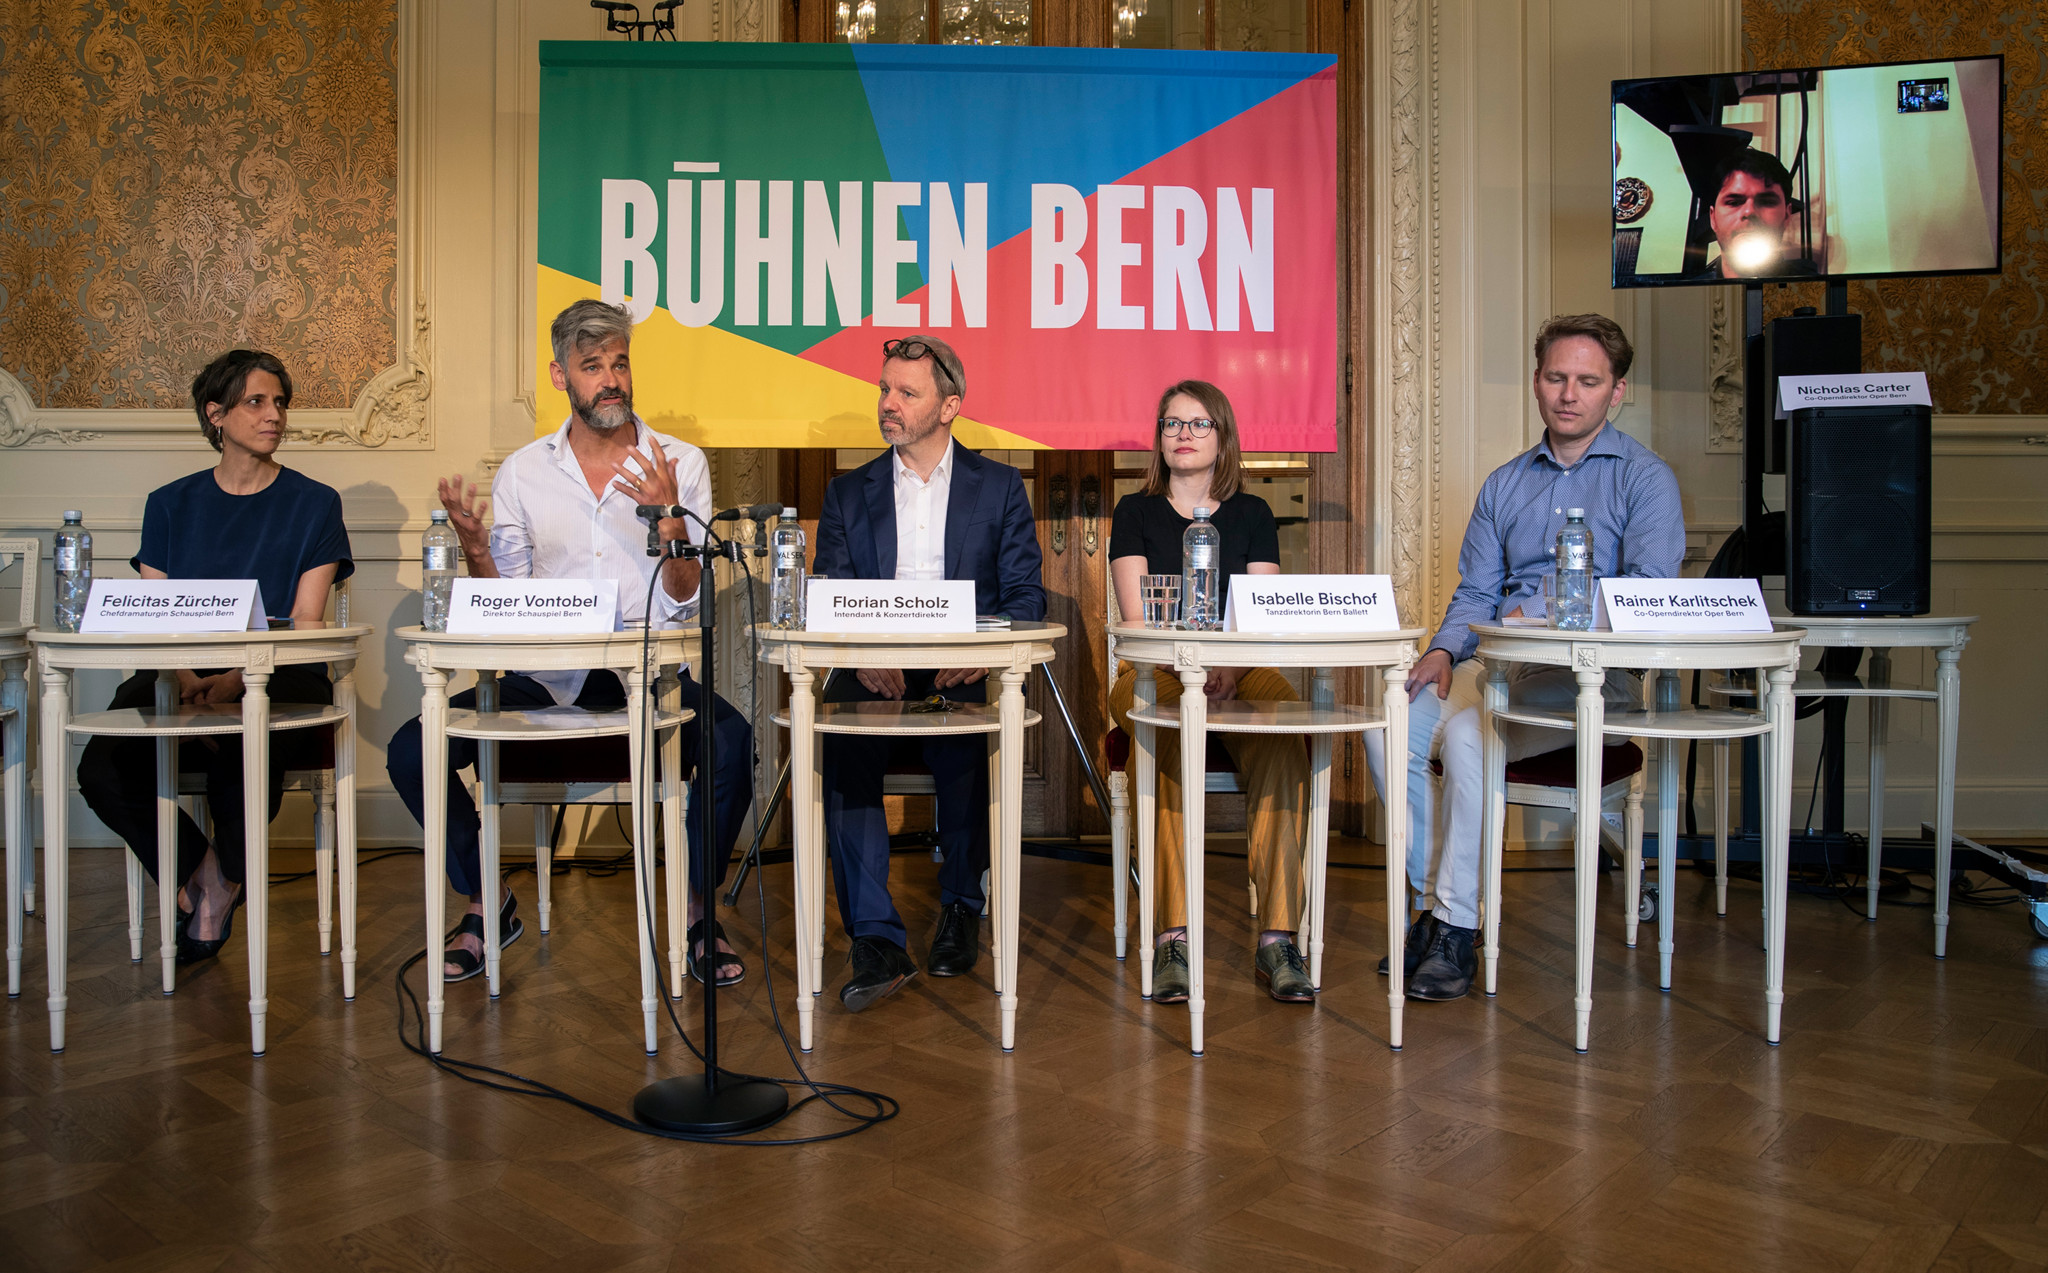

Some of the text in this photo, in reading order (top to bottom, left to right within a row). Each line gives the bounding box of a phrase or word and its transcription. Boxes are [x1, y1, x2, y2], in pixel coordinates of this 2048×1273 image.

[1030, 183, 1274, 332] BERN
[1797, 383, 1911, 395] Nicholas Carter
[102, 595, 239, 608] Felicitas Zürcher
[471, 594, 598, 609] Roger Vontobel
[833, 596, 949, 609] Florian Scholz
[1252, 592, 1377, 606] Isabelle Bischof
[1613, 594, 1758, 608] Rainer Karlitschek
[100, 610, 169, 618] Chefdramaturgin
[170, 610, 214, 618] Schauspiel
[517, 610, 562, 618] Schauspiel
[834, 611, 874, 619] Intendant
[883, 611, 947, 619] Konzertdirektor
[1265, 608, 1368, 616] Tanzdirektorin Bern Ballett
[1633, 610, 1703, 618] Co-Operndirektor
